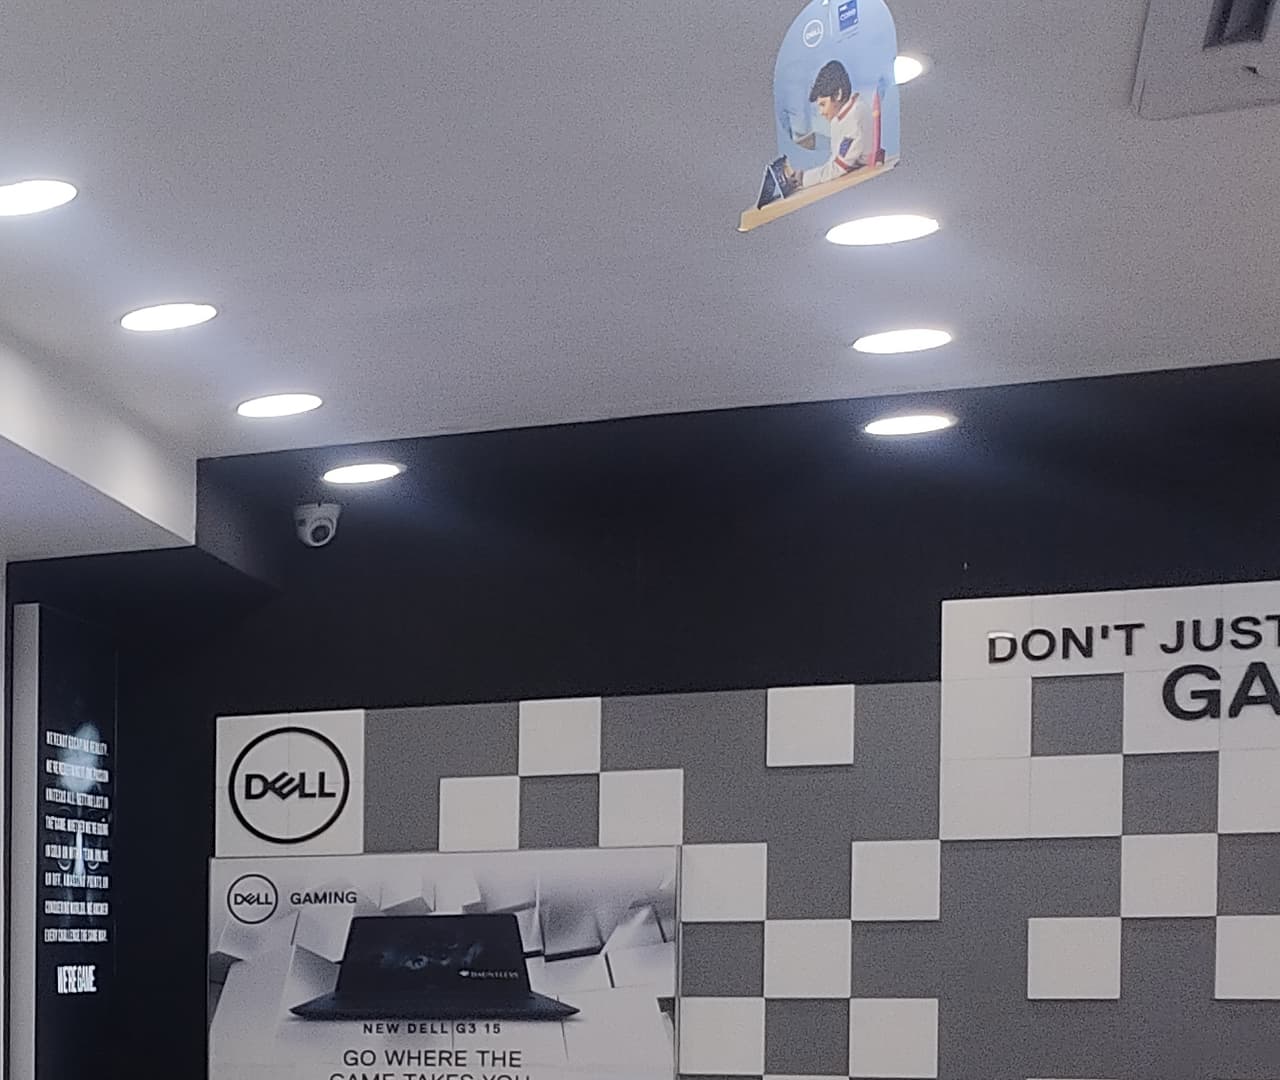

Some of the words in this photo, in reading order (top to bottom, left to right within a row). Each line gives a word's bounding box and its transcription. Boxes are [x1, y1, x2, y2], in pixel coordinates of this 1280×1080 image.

[988, 623, 1146, 664] DON'T
[244, 771, 337, 800] DELL
[233, 892, 273, 906] DELL
[290, 890, 358, 906] GAMING
[363, 1023, 400, 1034] NEW
[407, 1023, 448, 1034] DELL
[455, 1023, 477, 1034] G3
[484, 1023, 501, 1034] 15
[343, 1050, 377, 1067] GO
[384, 1050, 466, 1067] WHERE
[475, 1050, 522, 1068] THE
